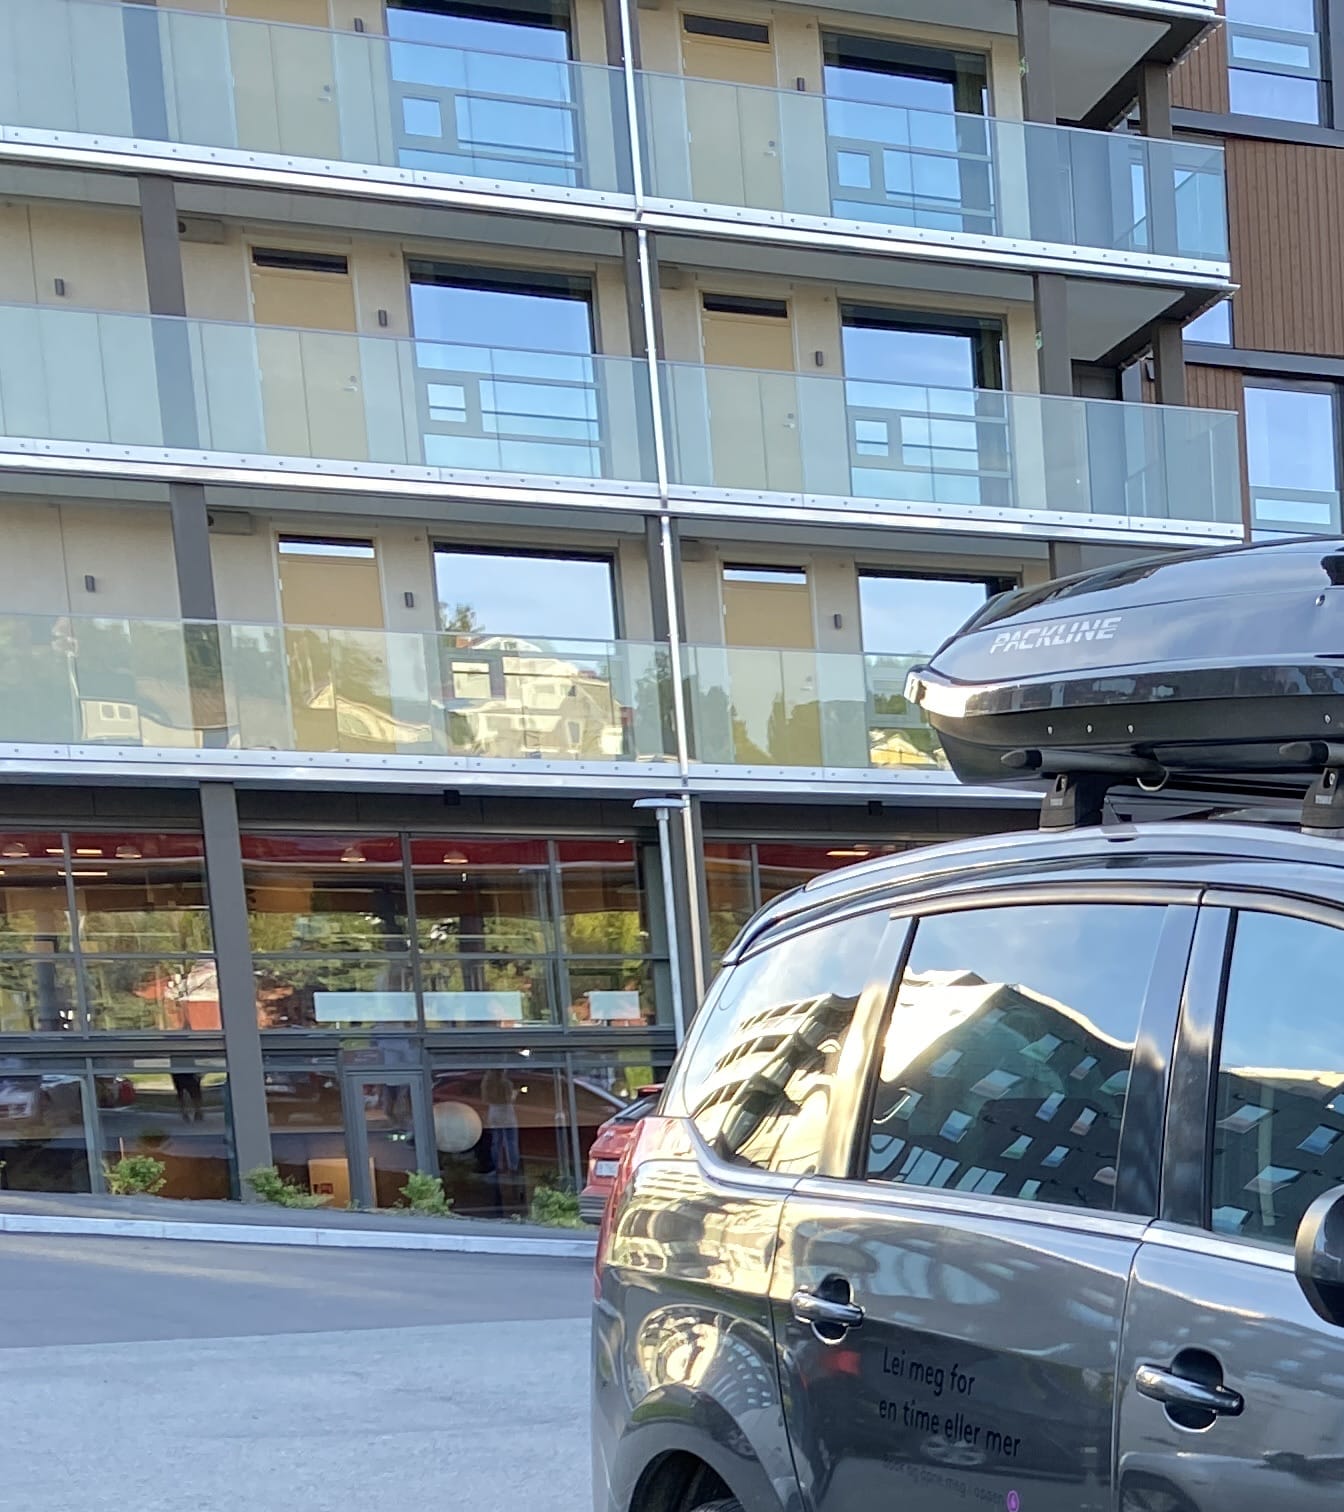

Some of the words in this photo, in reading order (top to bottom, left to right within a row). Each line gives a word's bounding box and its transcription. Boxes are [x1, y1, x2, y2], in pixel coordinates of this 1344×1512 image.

[990, 617, 1122, 654] PACKLINE
[882, 1346, 905, 1377] Lei
[909, 1361, 945, 1396] meg
[950, 1363, 976, 1396] for
[879, 1400, 897, 1420] en
[903, 1400, 940, 1434] time
[944, 1412, 981, 1445] eller
[985, 1430, 1021, 1457] mer
